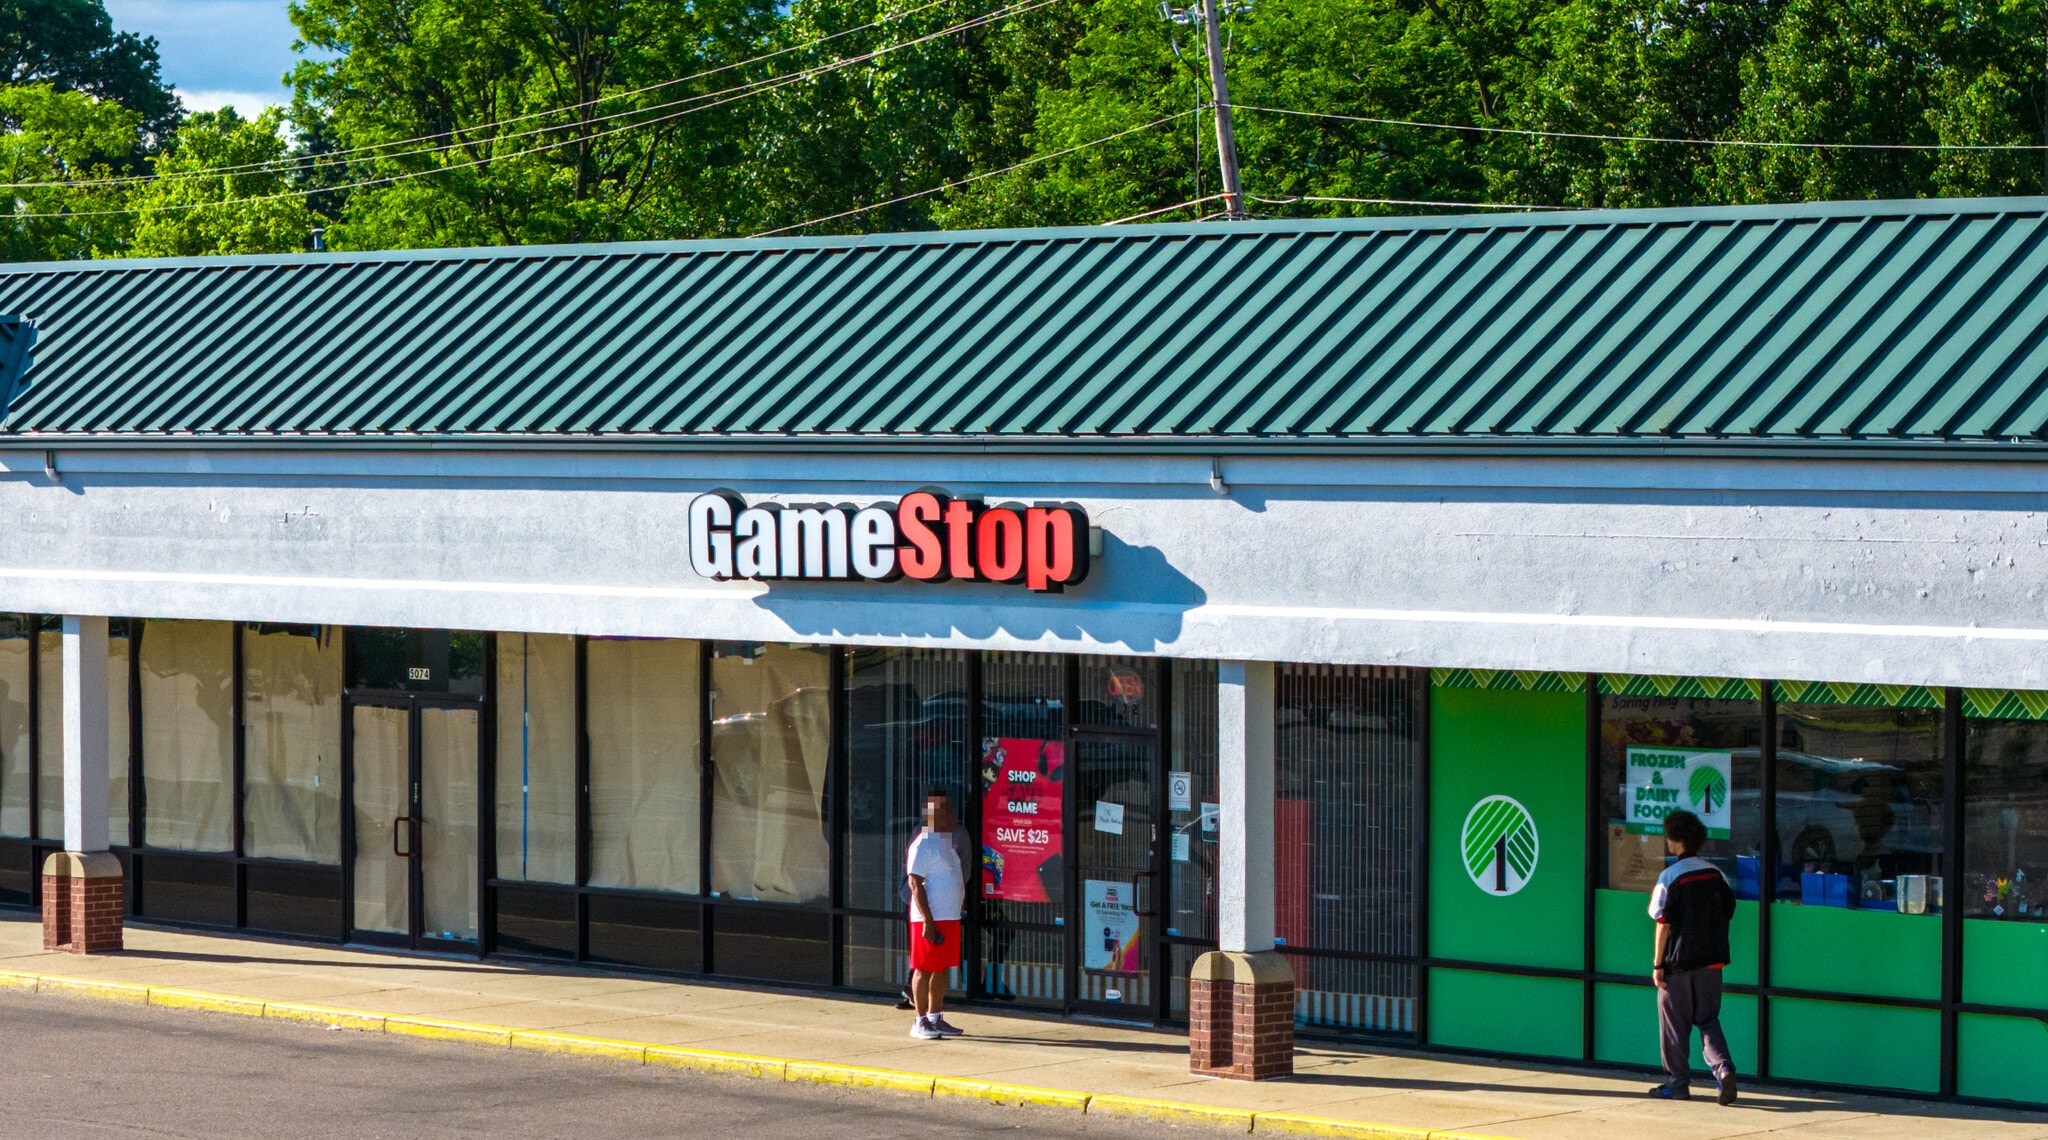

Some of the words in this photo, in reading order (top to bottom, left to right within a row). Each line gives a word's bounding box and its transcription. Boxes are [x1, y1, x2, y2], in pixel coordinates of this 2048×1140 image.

[690, 491, 1076, 591] GameStop
[409, 668, 429, 679] 5074
[1612, 697, 1650, 712] Spring
[1630, 753, 1686, 768] FROZEN
[1007, 769, 1036, 783] SHOP
[1651, 770, 1663, 785] &
[1636, 787, 1680, 803] DAIRY
[1007, 801, 1038, 815] GAME
[996, 827, 1025, 843] SAVE
[1027, 828, 1049, 845] $25
